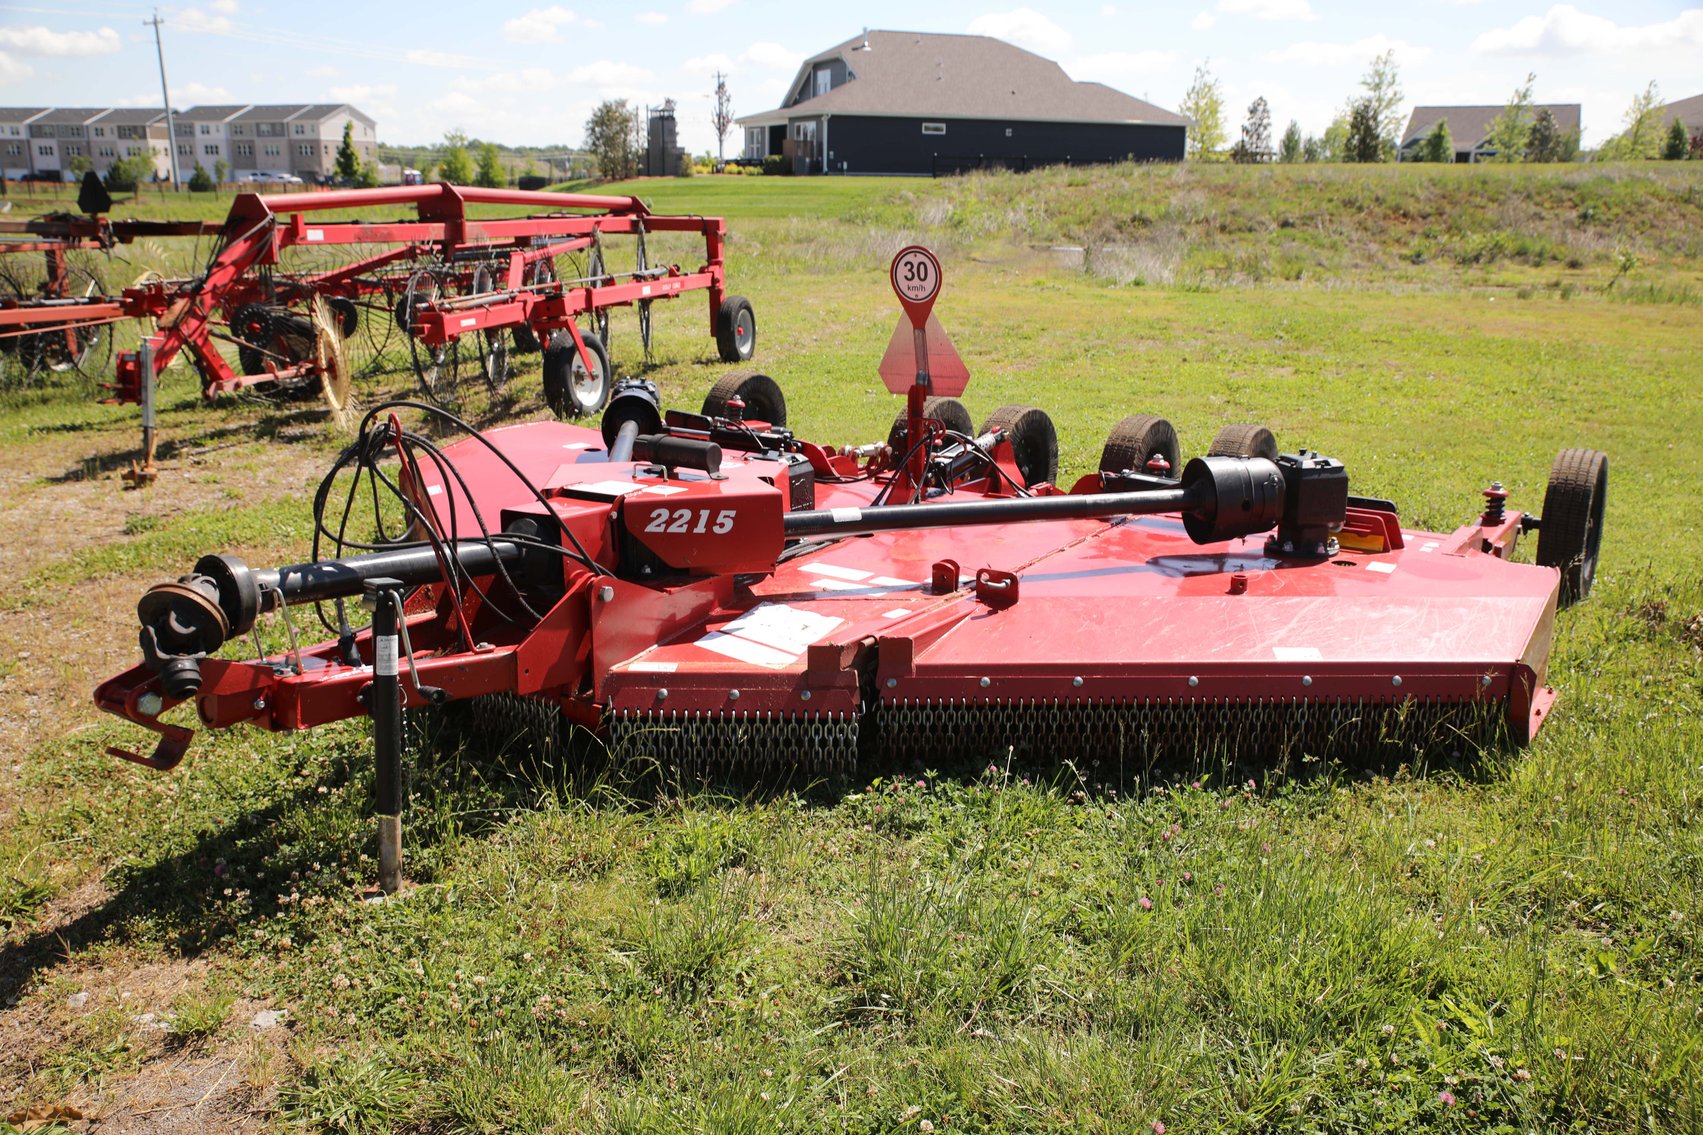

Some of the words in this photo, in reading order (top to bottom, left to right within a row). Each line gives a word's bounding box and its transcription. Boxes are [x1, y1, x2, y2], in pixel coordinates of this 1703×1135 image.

[904, 261, 928, 282] 30
[907, 284, 926, 292] km/h
[645, 508, 737, 534] 2215
